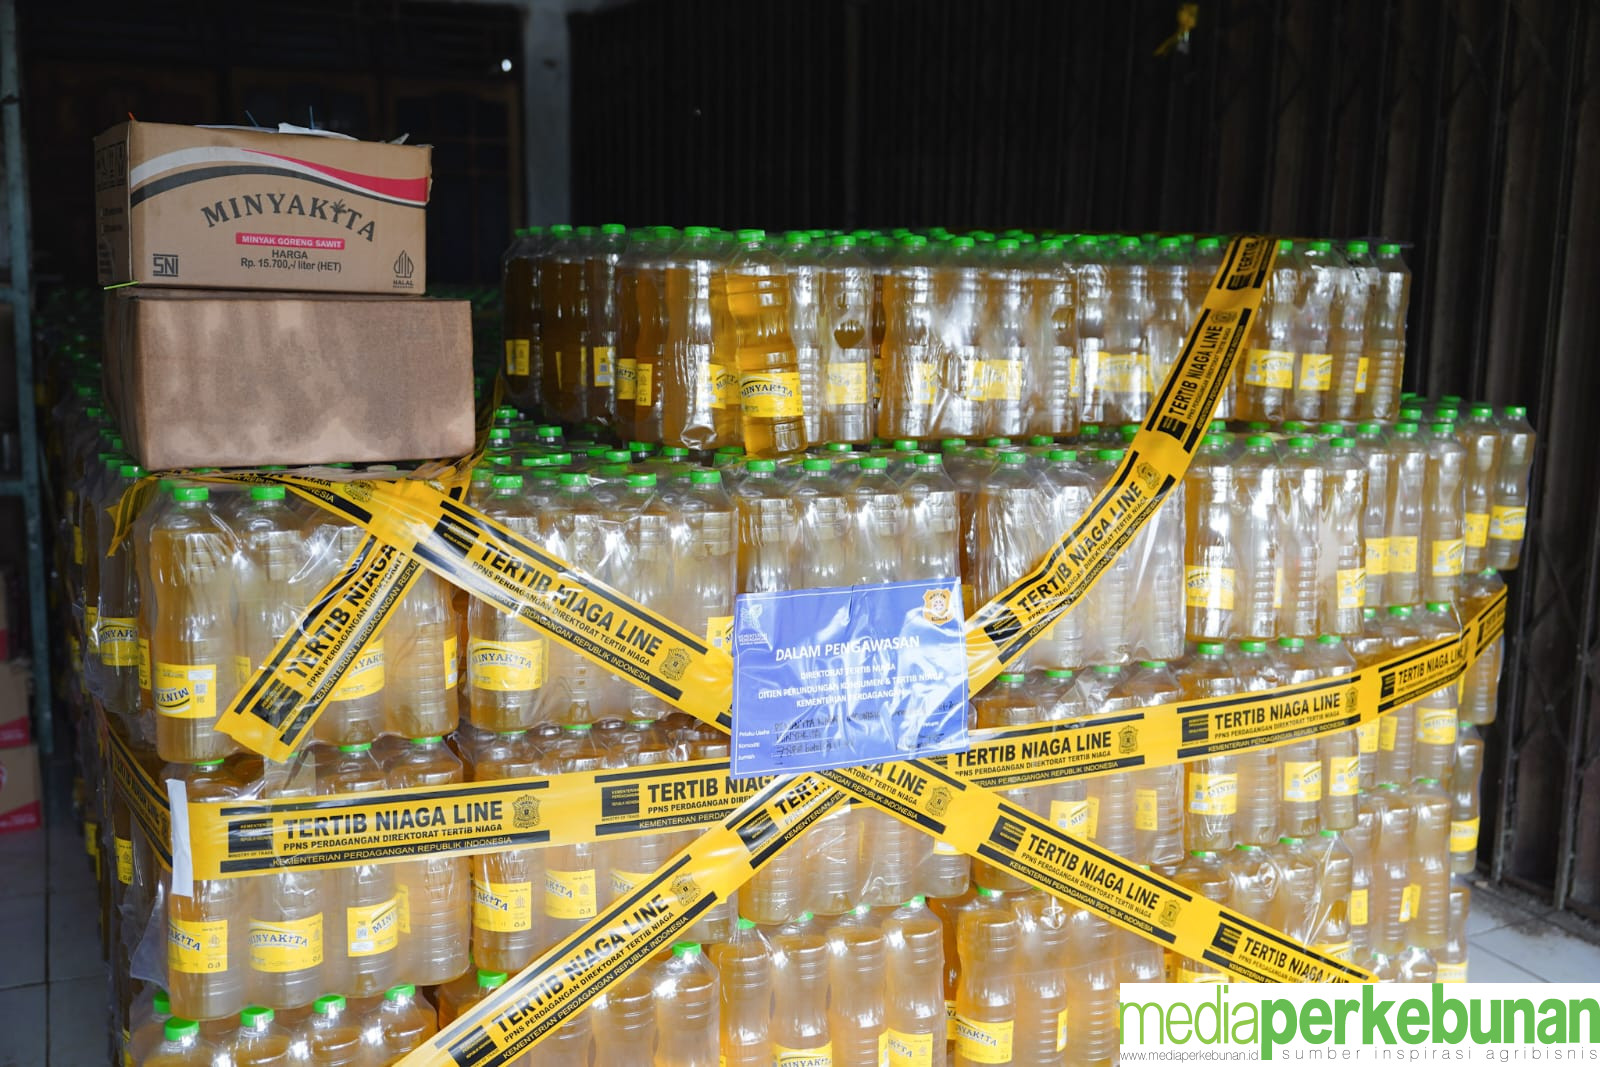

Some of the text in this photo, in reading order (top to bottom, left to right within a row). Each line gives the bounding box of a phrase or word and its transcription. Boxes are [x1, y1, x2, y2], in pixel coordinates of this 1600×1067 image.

[201, 194, 375, 242] MINYAKITA
[242, 235, 343, 248] MINYAK GORENG SAWIT
[272, 250, 308, 260] HARGA
[153, 254, 178, 277] SNI
[241, 258, 256, 269] Rp.
[298, 260, 315, 270] liter
[317, 262, 342, 273] (HET)
[1168, 325, 1223, 417] TERTIB NIAGA LINE
[1017, 563, 1071, 613] TERTIB
[1069, 518, 1112, 567] NIAGA
[1109, 481, 1142, 520] LINE
[285, 606, 351, 680] TERTIB
[344, 543, 397, 608] NIAGA
[470, 561, 493, 578] PPNS
[552, 606, 600, 638] DIREKTORAT
[599, 633, 627, 653] TERTIB
[627, 648, 651, 666] NIAGA
[477, 541, 663, 657] TERTIB NIAGA LINE
[306, 664, 329, 688] PPNS
[323, 608, 367, 670] PERDAGANGAN
[313, 647, 358, 706] KEMENTERIAN
[356, 587, 401, 650] PERDAGANGAN
[573, 635, 611, 661] REPUBLIK
[609, 655, 651, 683] INDONESIA
[776, 636, 920, 662] DALAM PENGAWASAN
[1399, 663, 1425, 684] TERTIB
[1427, 654, 1449, 673] NIAGA
[1215, 706, 1264, 731] TERTIB
[1270, 697, 1308, 720] NIAGA
[1313, 692, 1339, 712] LINE
[955, 730, 1110, 769] TERTIB NIAGA LINE
[974, 762, 1022, 775] PERDAGANGAN
[1067, 752, 1089, 762] TERTIB
[1091, 749, 1110, 758] NIAGA
[647, 775, 780, 803] TERTIB NIAG
[873, 779, 896, 795] TERTIB
[896, 790, 918, 805] NIAGA
[886, 764, 927, 796] LINE
[283, 800, 502, 840] TERTIB NIAGA LINE
[639, 815, 695, 828] KEMENTERIAN
[648, 804, 668, 814] PPNS
[670, 798, 727, 811] PERDAGANGAN
[784, 801, 830, 841] KEMENTERIAN
[852, 784, 885, 802] REPUBLIK
[884, 798, 918, 820] INDONESIA
[272, 835, 511, 867] KEMENTERIAN PERDAGANGAN REPUBLIK INDONESIA
[283, 823, 502, 851] PPNS PERDAGANGAN DIREKTORAT TERTIB NIAGA
[1020, 851, 1152, 919] PPNS PERDAGANGAN DIREKTORAT TERTIB NIAGA
[1025, 833, 1160, 910] TERTIB NIAGA LINE
[1009, 859, 1154, 933] KEMENTERIAN PERDAGANGAN REPUBLIK INDONESIA
[490, 892, 670, 1035] TERTIB NIAGA LINE
[502, 910, 675, 1043] PPNS PERDAGANGAN DIREKTORAT TERTIB NIAGA
[1242, 937, 1288, 969] TERTIB
[1287, 956, 1324, 984] NIAGA
[502, 916, 689, 1059] KEMENTERIAN PERDAGANGAN REPUBLIK INDONESIA
